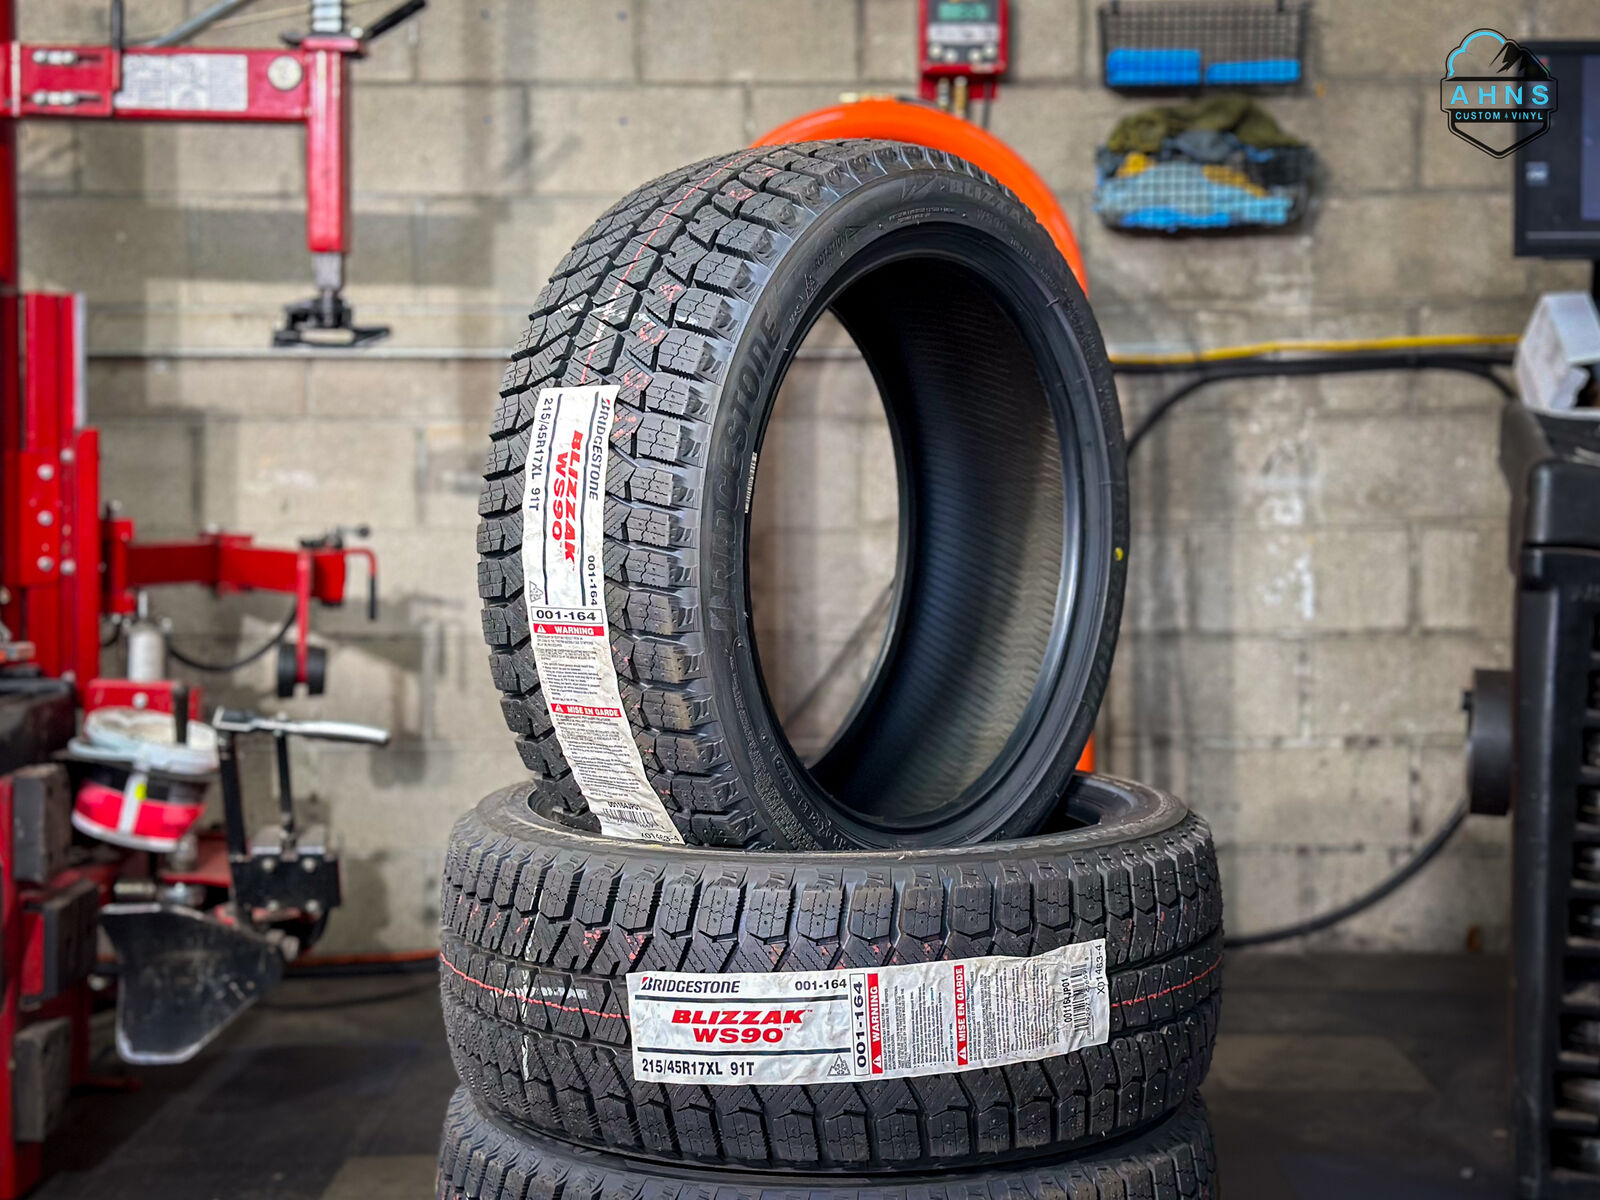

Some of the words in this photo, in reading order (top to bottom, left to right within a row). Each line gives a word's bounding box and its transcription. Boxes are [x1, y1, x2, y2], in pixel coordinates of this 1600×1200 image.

[531, 397, 554, 480] 215/45R17XL
[589, 398, 610, 501] BRIDGESTONE
[529, 489, 541, 511] 91T
[552, 452, 569, 541] WS90
[564, 430, 583, 562] BLIZZAK
[588, 556, 598, 606] 001-164
[536, 610, 596, 621] 001-164
[554, 626, 594, 635] WARNING
[567, 706, 584, 714] MISE
[595, 708, 619, 717] GARDE
[1096, 944, 1105, 995] X01463-4
[641, 976, 740, 993] BRIDGESTONE
[795, 978, 847, 991] 001-164
[955, 967, 964, 1001] GARDE
[671, 1009, 807, 1025] BLIZZAK
[870, 985, 879, 1042] WARNING
[956, 1002, 966, 1017] EN
[693, 1028, 783, 1044] WS90
[853, 981, 867, 1067] 001-164
[957, 1018, 967, 1042] MISE
[642, 1058, 723, 1076] 215/45R17XL
[730, 1062, 754, 1076] 91T
